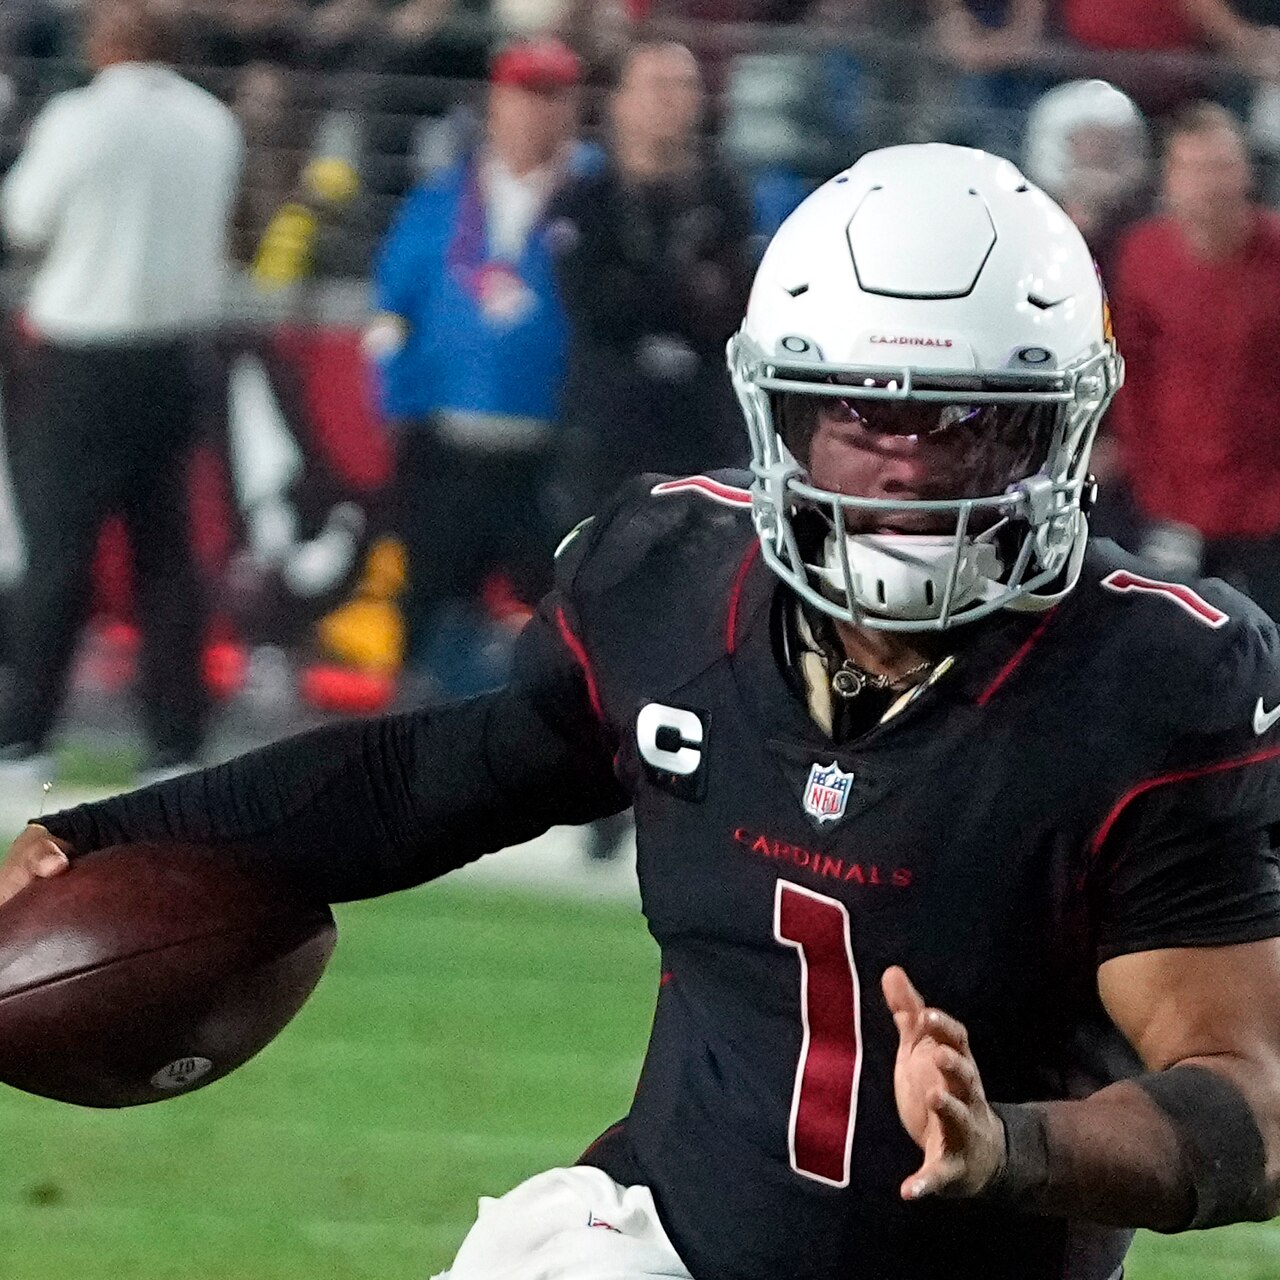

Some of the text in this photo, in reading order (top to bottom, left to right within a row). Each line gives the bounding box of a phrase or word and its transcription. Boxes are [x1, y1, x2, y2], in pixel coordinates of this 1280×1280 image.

[869, 334, 954, 348] CARDINALS
[1100, 569, 1230, 629] 1
[637, 702, 703, 775] C
[733, 828, 913, 887] CARDINALS
[773, 878, 863, 1188] 1
